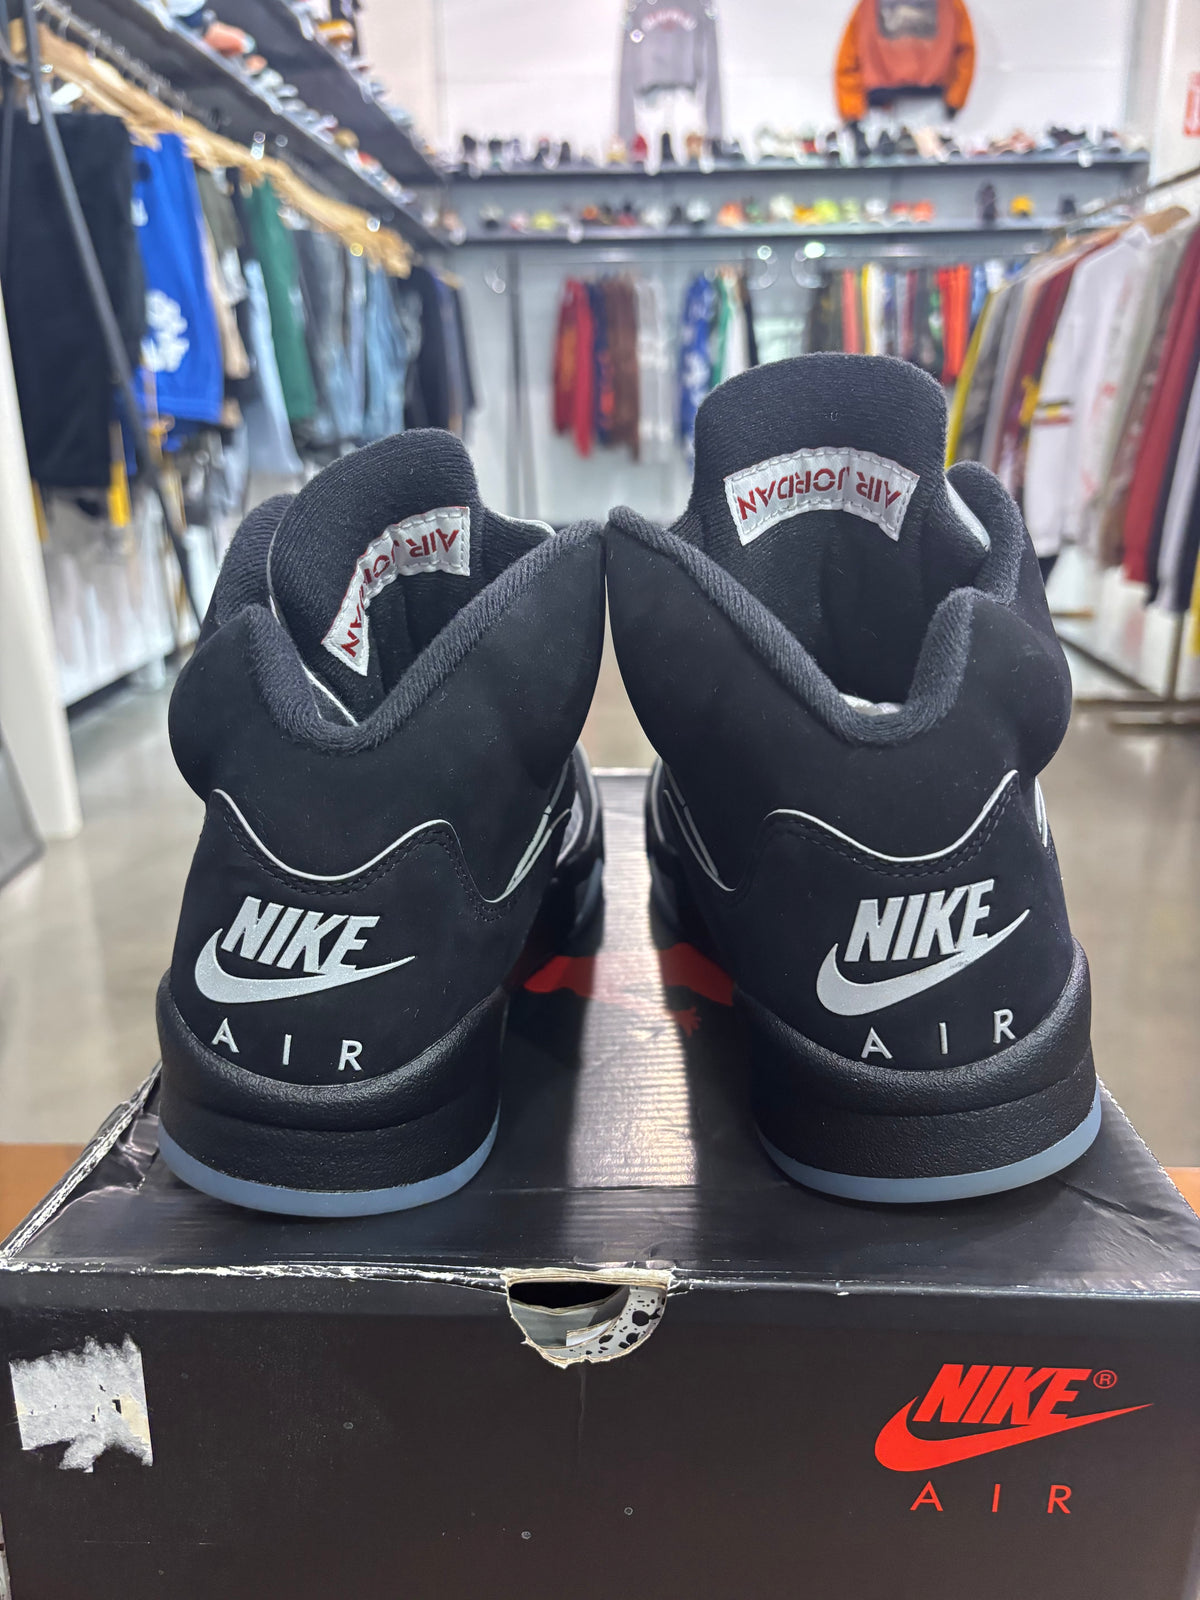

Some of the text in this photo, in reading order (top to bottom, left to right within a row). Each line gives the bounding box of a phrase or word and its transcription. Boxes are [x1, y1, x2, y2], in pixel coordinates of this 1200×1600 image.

[736, 466, 902, 520] AIR JORDAN
[405, 528, 460, 558] AIR
[220, 896, 381, 976] NIKE
[843, 878, 995, 962] NIKE
[211, 1017, 364, 1072] AIR
[860, 1008, 1016, 1060] AIR
[909, 1480, 1073, 1514] AIR
